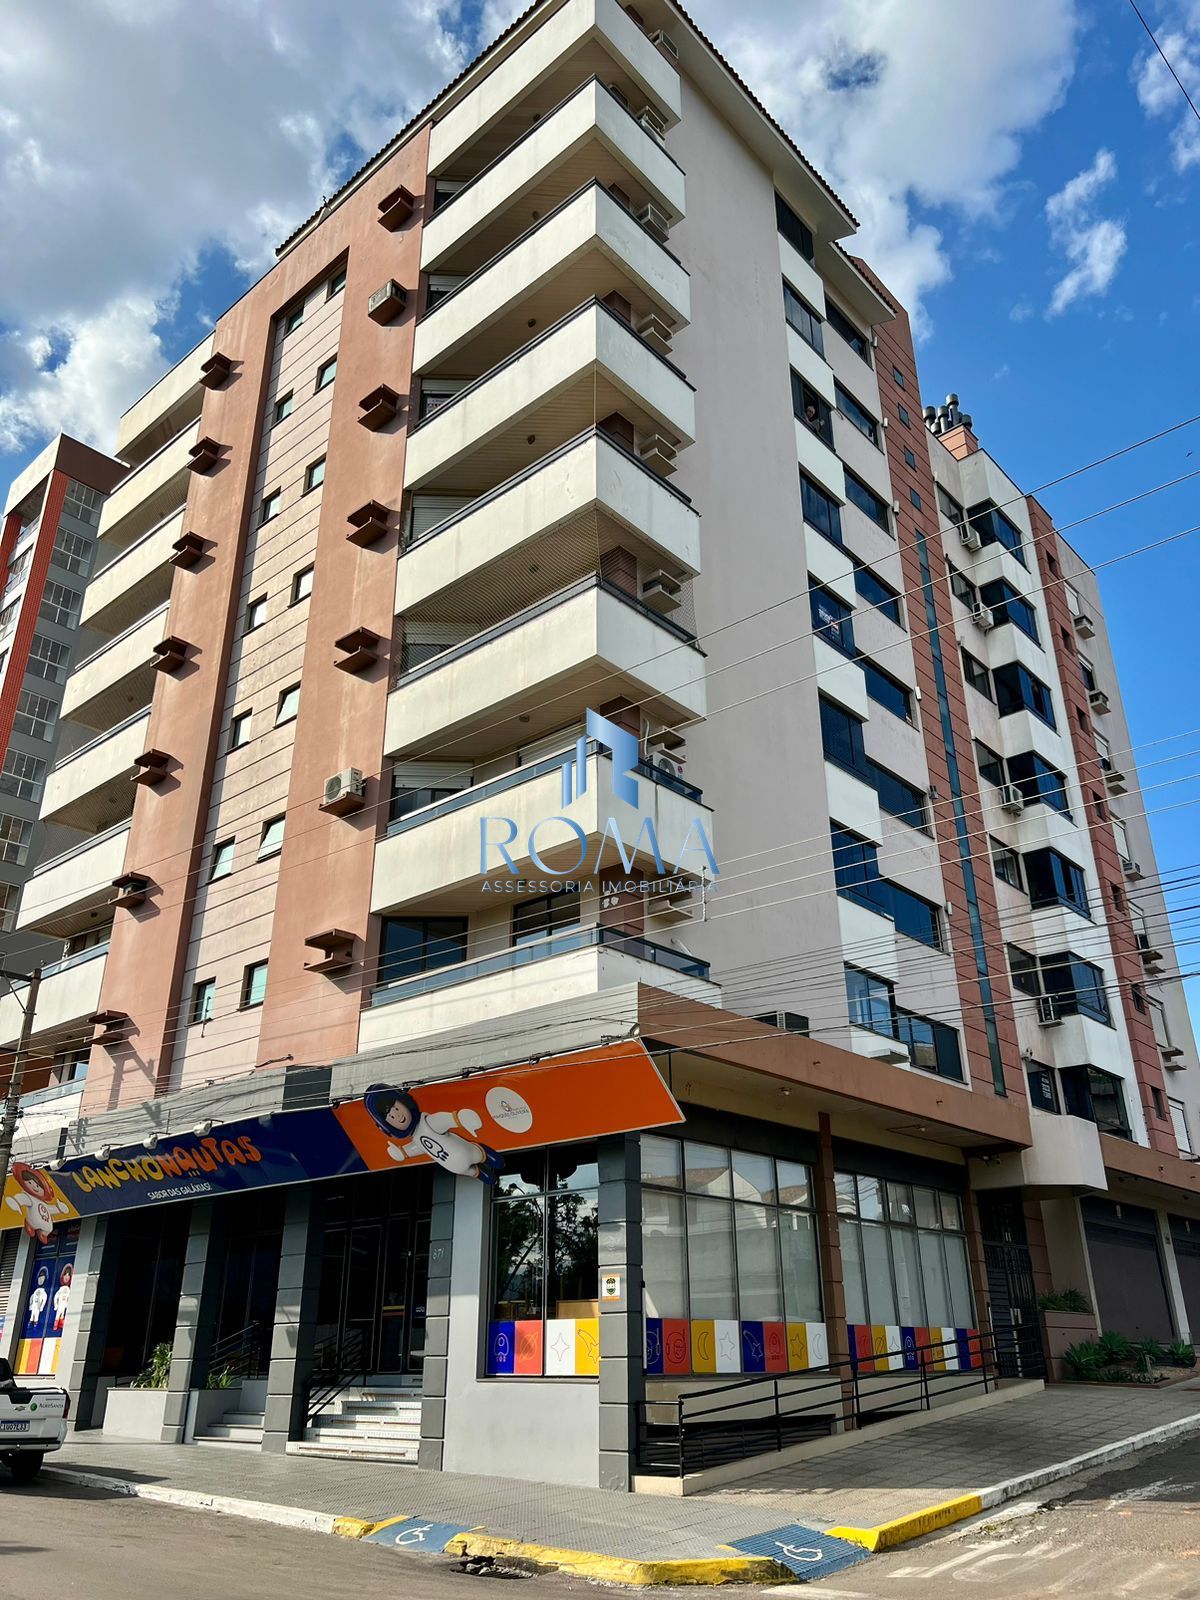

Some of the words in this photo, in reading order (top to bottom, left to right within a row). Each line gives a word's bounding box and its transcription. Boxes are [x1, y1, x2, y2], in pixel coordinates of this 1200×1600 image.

[72, 1136, 262, 1193] LANCHONAUTAS
[147, 1190, 170, 1200] SABOR
[167, 1187, 182, 1197] DAS
